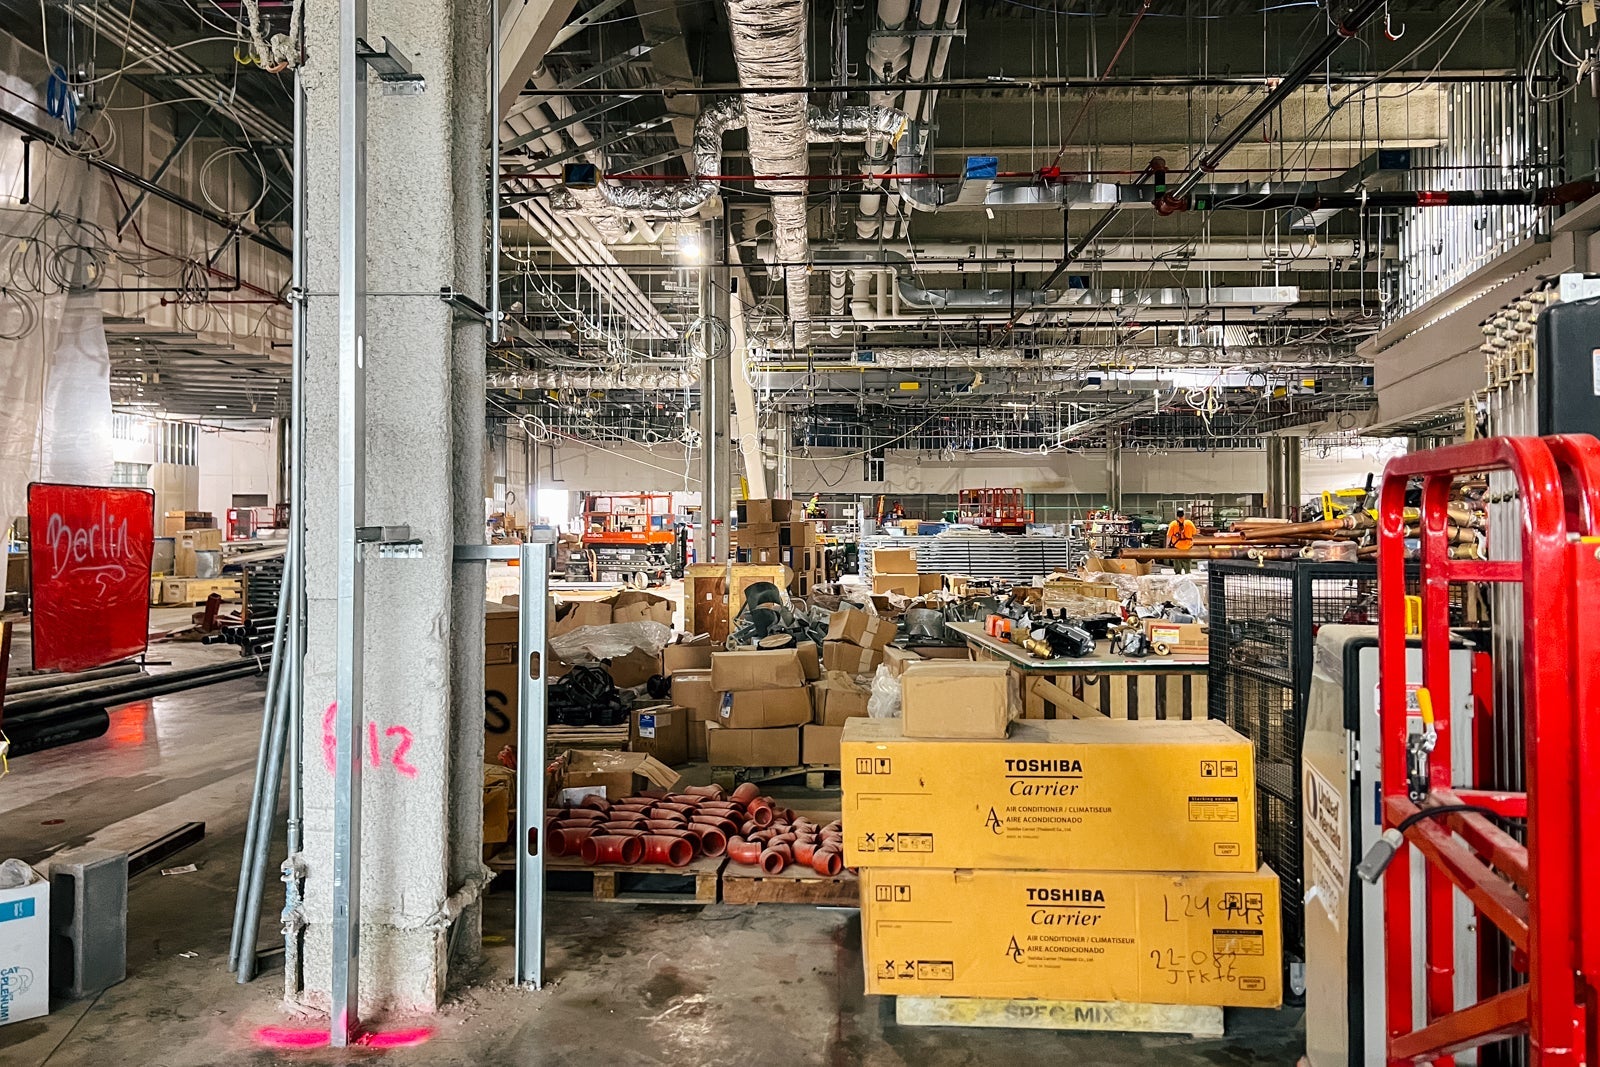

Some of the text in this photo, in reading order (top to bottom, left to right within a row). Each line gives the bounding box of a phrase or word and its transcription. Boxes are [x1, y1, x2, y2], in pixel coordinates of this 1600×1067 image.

[46, 501, 133, 579] Berlin
[1005, 759, 1083, 773] TOSHIBA
[1009, 780, 1079, 796] Carrier
[1026, 888, 1105, 902] TOSHIBA
[1031, 910, 1101, 926] Carrier
[1039, 935, 1085, 943] CONDITIONER
[1044, 945, 1105, 953] ACONDICIONADO
